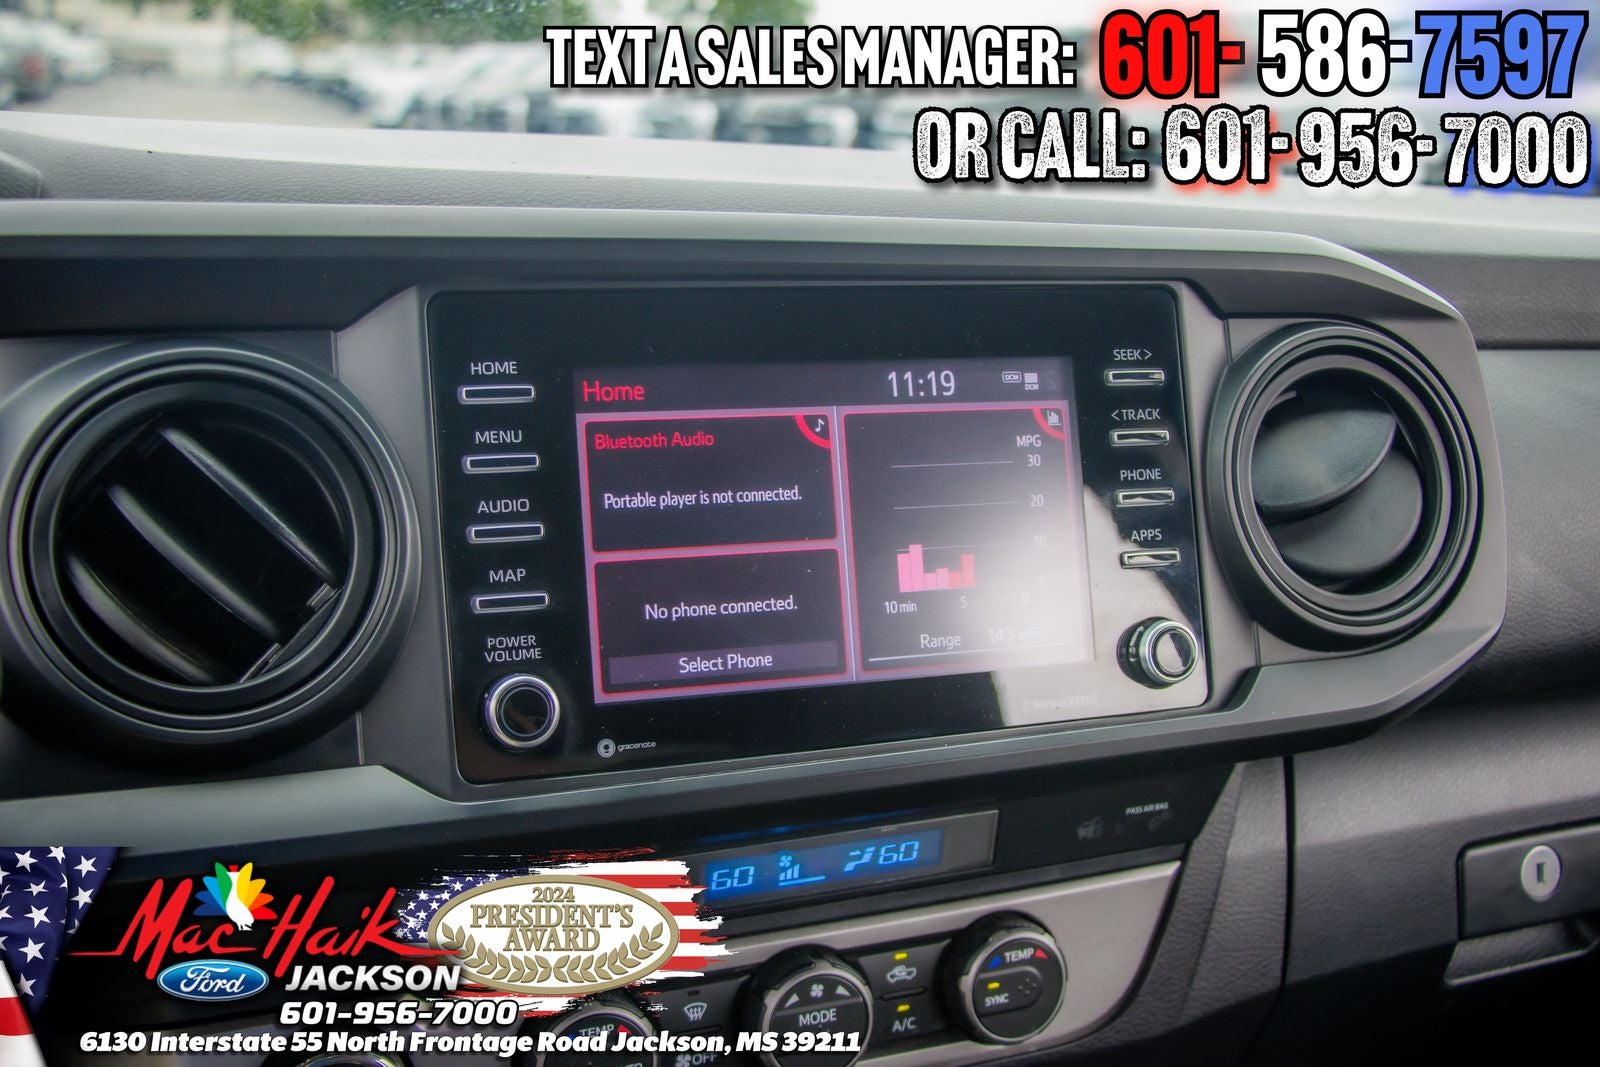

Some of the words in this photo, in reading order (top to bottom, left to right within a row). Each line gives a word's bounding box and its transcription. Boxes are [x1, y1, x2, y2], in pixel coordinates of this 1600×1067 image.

[470, 361, 518, 376] HOME
[582, 380, 646, 402] Home
[887, 369, 956, 398] 11:19
[475, 430, 523, 444] MENU
[594, 433, 668, 450] Bluetooth
[671, 431, 715, 448] Audio
[1016, 434, 1042, 447] MPG
[1026, 454, 1042, 467] 30
[1119, 468, 1163, 481] PHONE
[604, 492, 657, 509] Portable
[660, 490, 697, 509] player
[699, 490, 710, 505] is
[712, 489, 734, 504] not
[736, 484, 803, 503] connected.
[1030, 494, 1045, 507] 20
[477, 498, 530, 513] AUDIO
[1131, 529, 1162, 541] APPS
[489, 568, 527, 583] MAP
[645, 603, 669, 620] No
[672, 602, 717, 621] phone
[720, 595, 798, 615] connected.
[884, 600, 898, 614] 10
[899, 601, 918, 613] min
[960, 596, 968, 609] 5
[487, 635, 537, 649] POWER
[920, 633, 962, 650] Range
[484, 648, 543, 663] VOLUME
[679, 656, 724, 673] Select
[727, 653, 773, 670] Phone
[617, 739, 657, 752] gracenote
[1125, 806, 1143, 815] PASS
[878, 841, 919, 865] 60
[711, 866, 755, 890] 60
[1005, 948, 1034, 962] TEMP
[984, 994, 1009, 1006] SYNC
[799, 1009, 837, 1026] MODE
[892, 1017, 916, 1032] A/C
